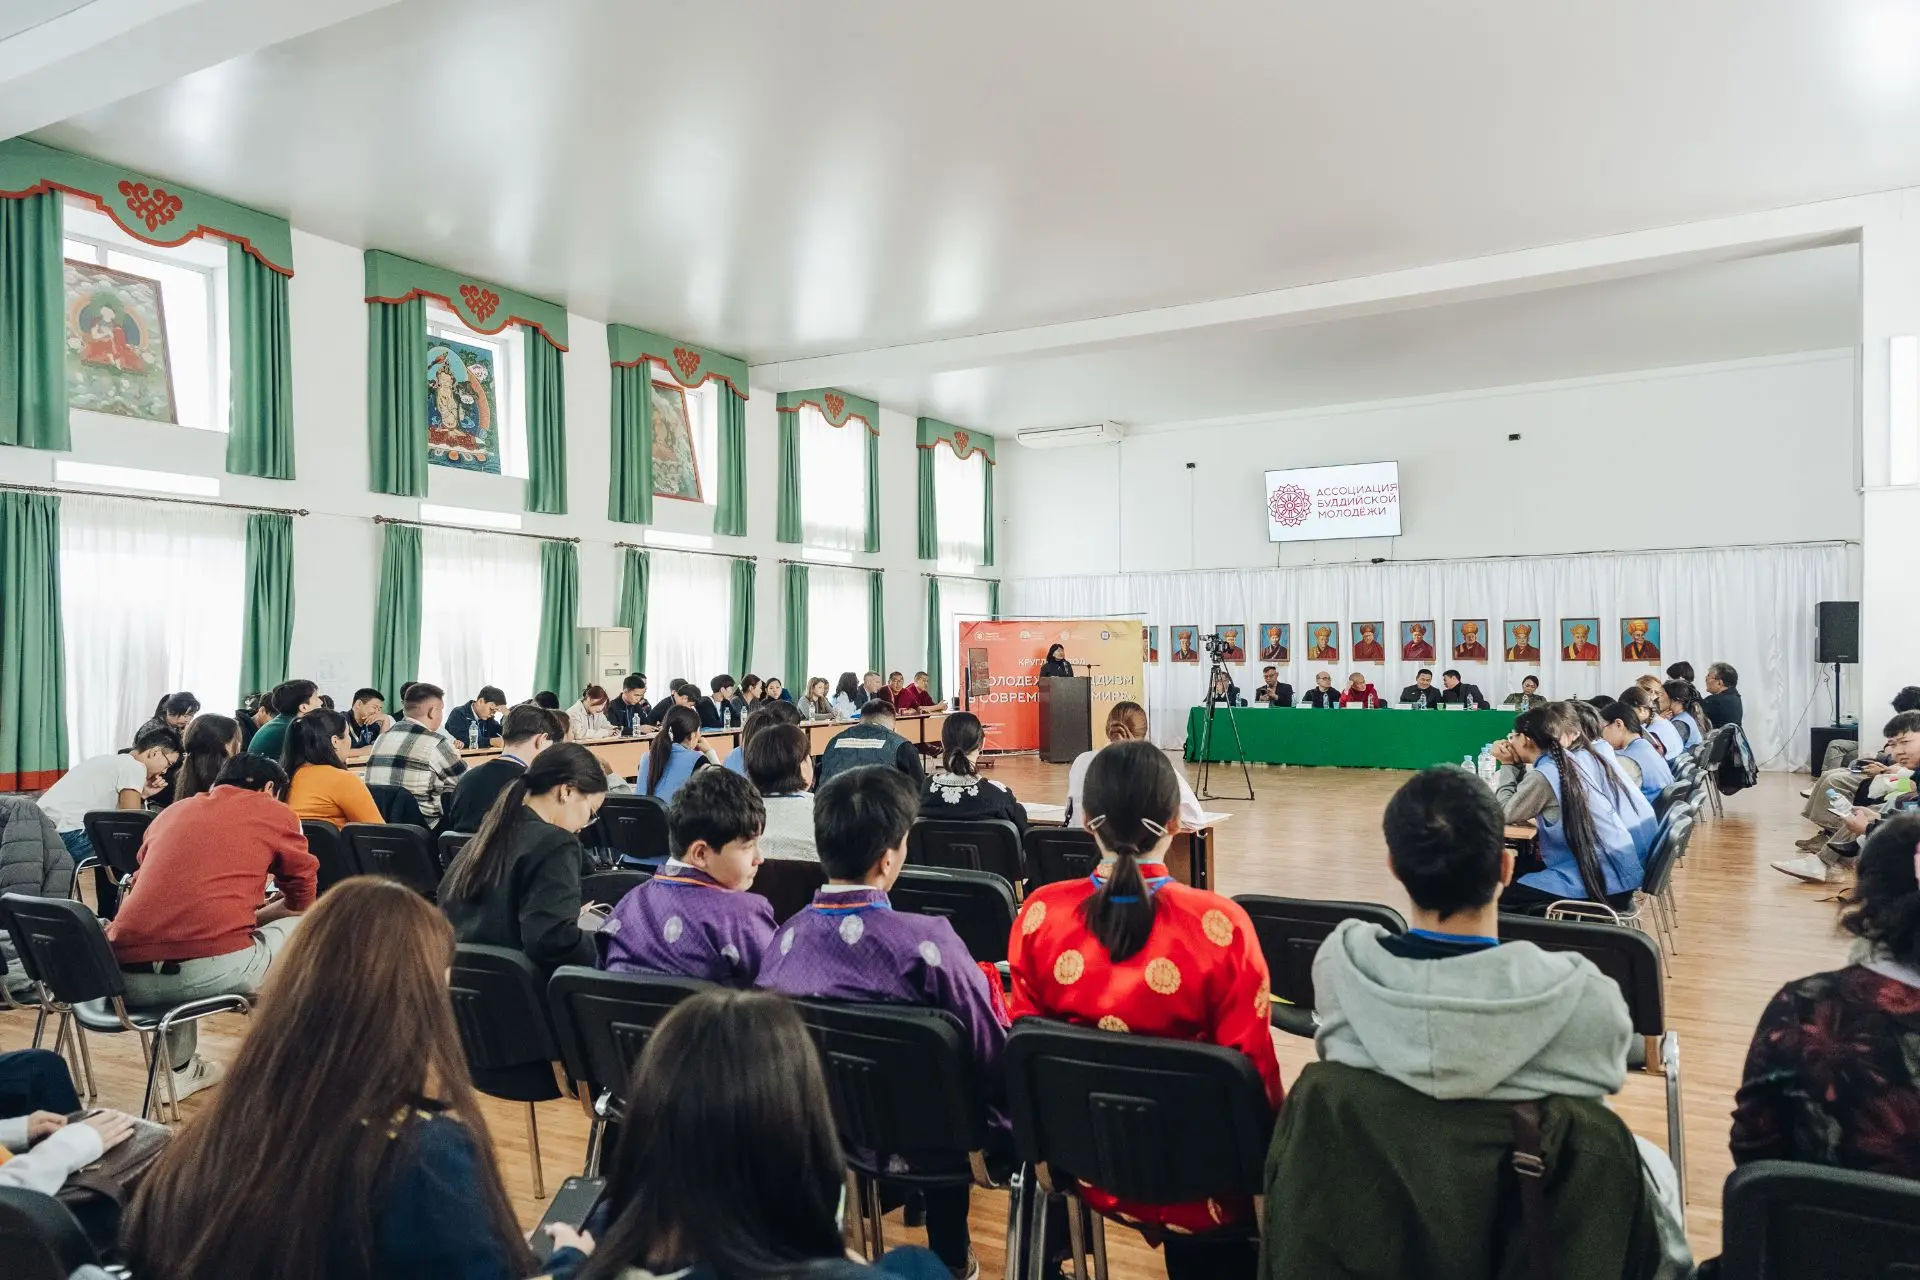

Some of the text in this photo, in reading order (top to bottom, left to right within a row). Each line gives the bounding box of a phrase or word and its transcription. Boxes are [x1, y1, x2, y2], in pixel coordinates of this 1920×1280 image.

[1317, 483, 1397, 496] АССОЦИАЦИЯ
[1317, 493, 1397, 507] БУДДИЙСКОЙ
[1018, 658, 1048, 666] КРУГЛ
[979, 692, 1040, 703] СОВРЕМ
